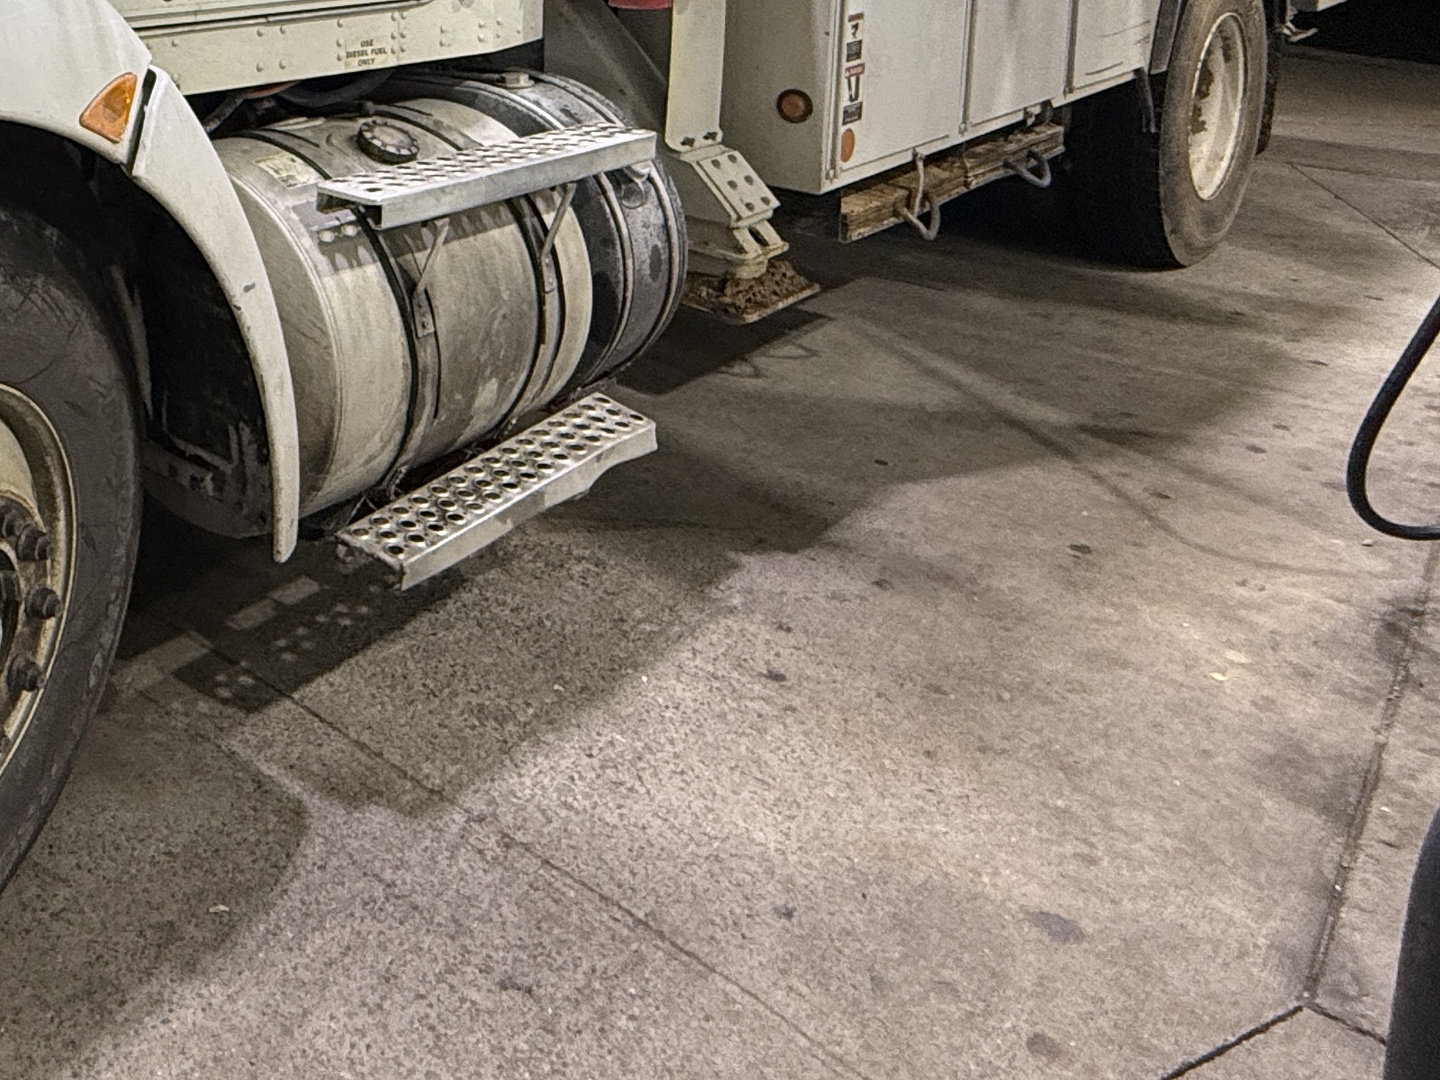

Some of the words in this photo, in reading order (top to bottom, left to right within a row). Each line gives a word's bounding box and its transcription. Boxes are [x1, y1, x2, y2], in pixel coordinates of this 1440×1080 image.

[360, 39, 374, 48] USE
[345, 49, 369, 59] DIESEL
[370, 47, 388, 56] FUEL
[357, 57, 375, 67] ONLY
